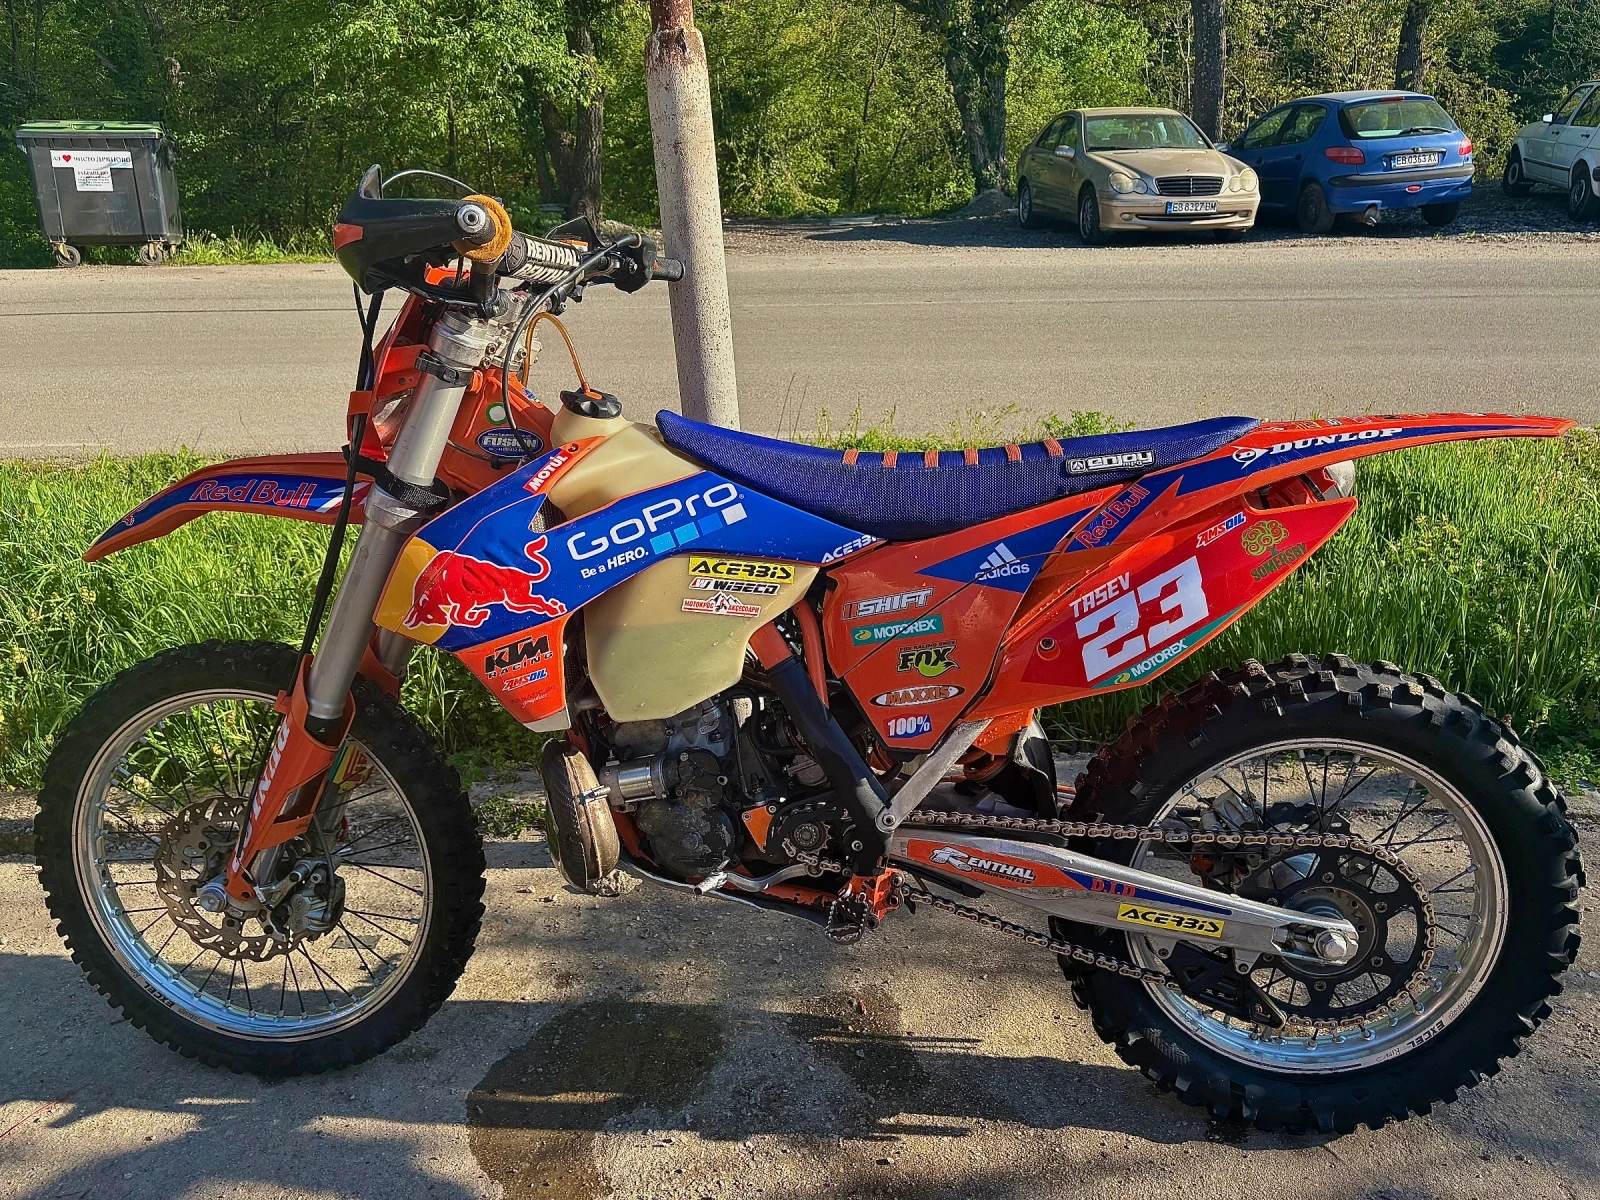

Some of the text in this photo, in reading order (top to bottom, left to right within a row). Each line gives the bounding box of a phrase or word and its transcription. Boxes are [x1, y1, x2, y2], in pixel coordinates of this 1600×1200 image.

[1397, 156, 1406, 165] EB
[1173, 202, 1183, 211] EB
[526, 238, 580, 267] RENTHAL
[1269, 427, 1405, 455] DUNLOP
[528, 454, 569, 491] MOTUL
[1087, 452, 1153, 469] enjoy
[189, 479, 317, 508] Red Bull
[567, 483, 738, 560] GoPro
[1075, 483, 1150, 549] Red Bull
[1196, 511, 1246, 548] AMSOIL
[581, 546, 649, 579] Be a HERO.
[691, 560, 792, 579] ACERBIS
[975, 562, 1030, 581] adidas
[857, 588, 934, 617] SHIFT
[1069, 572, 1131, 618] TASEV
[873, 619, 936, 639] MOTOREX
[1075, 555, 1210, 682] 23
[485, 635, 550, 675] KTM
[488, 651, 554, 679] RACING
[897, 646, 959, 677] FOX
[1131, 638, 1188, 677] MOTOREX
[502, 668, 548, 691] AMSOIL
[886, 686, 950, 706] MAXXIS
[887, 715, 931, 737] 100%
[1091, 878, 1136, 897] D.I.D
[1121, 908, 1220, 933] ACERBIS
[142, 983, 175, 1008] EXCEL
[1406, 1020, 1446, 1048] EXCEL
